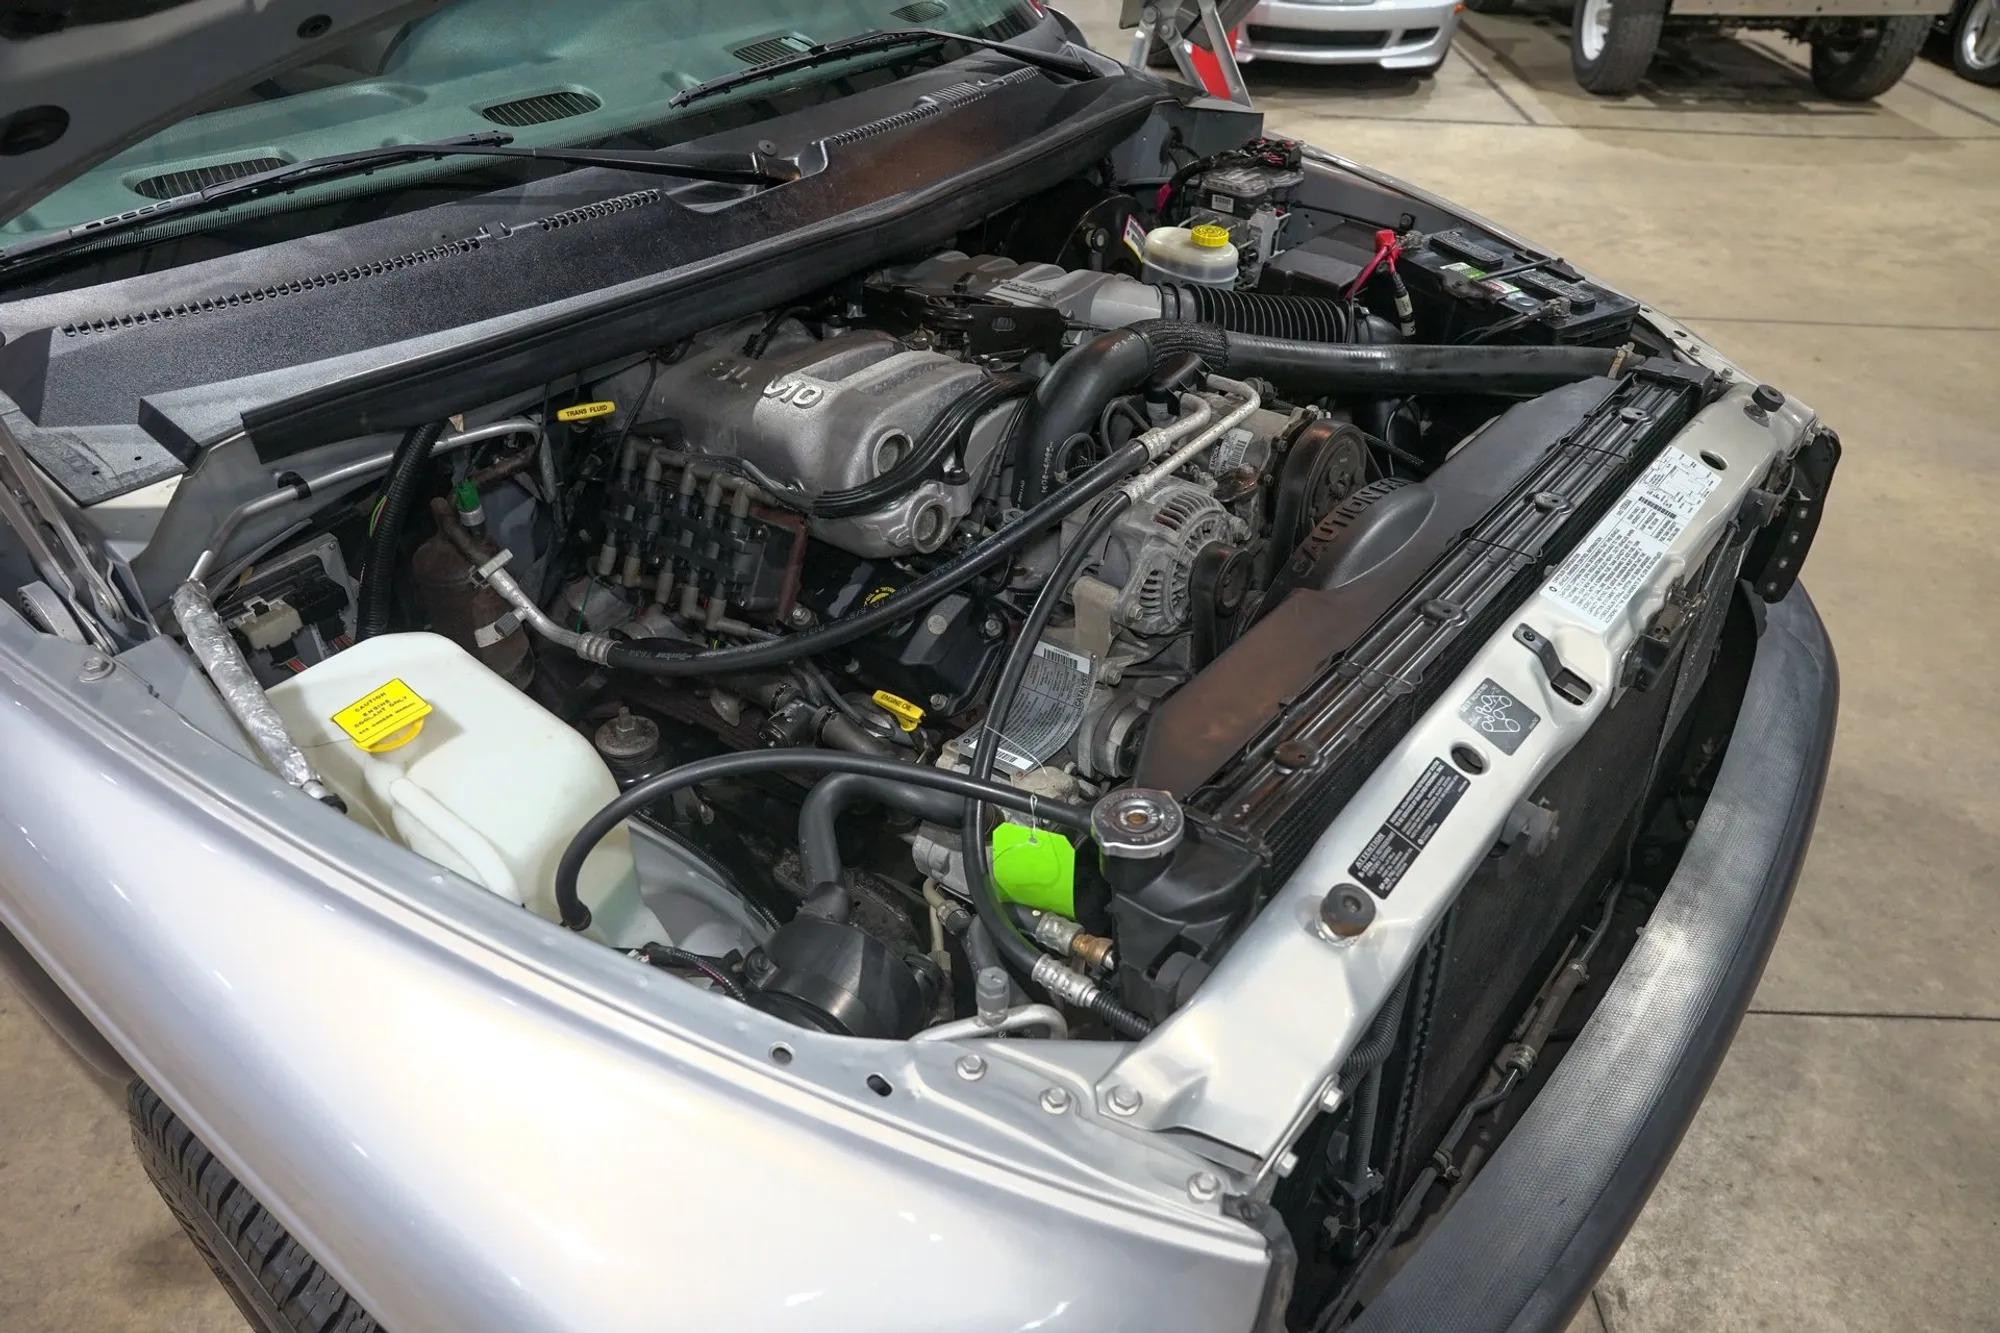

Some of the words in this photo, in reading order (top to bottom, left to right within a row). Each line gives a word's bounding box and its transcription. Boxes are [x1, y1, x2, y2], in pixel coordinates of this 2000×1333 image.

[763, 376, 824, 409] V10
[566, 408, 588, 417] TRANS
[589, 404, 608, 413] FLUID
[354, 691, 386, 712] CAUTION
[1353, 831, 1385, 869] ATTENTION
